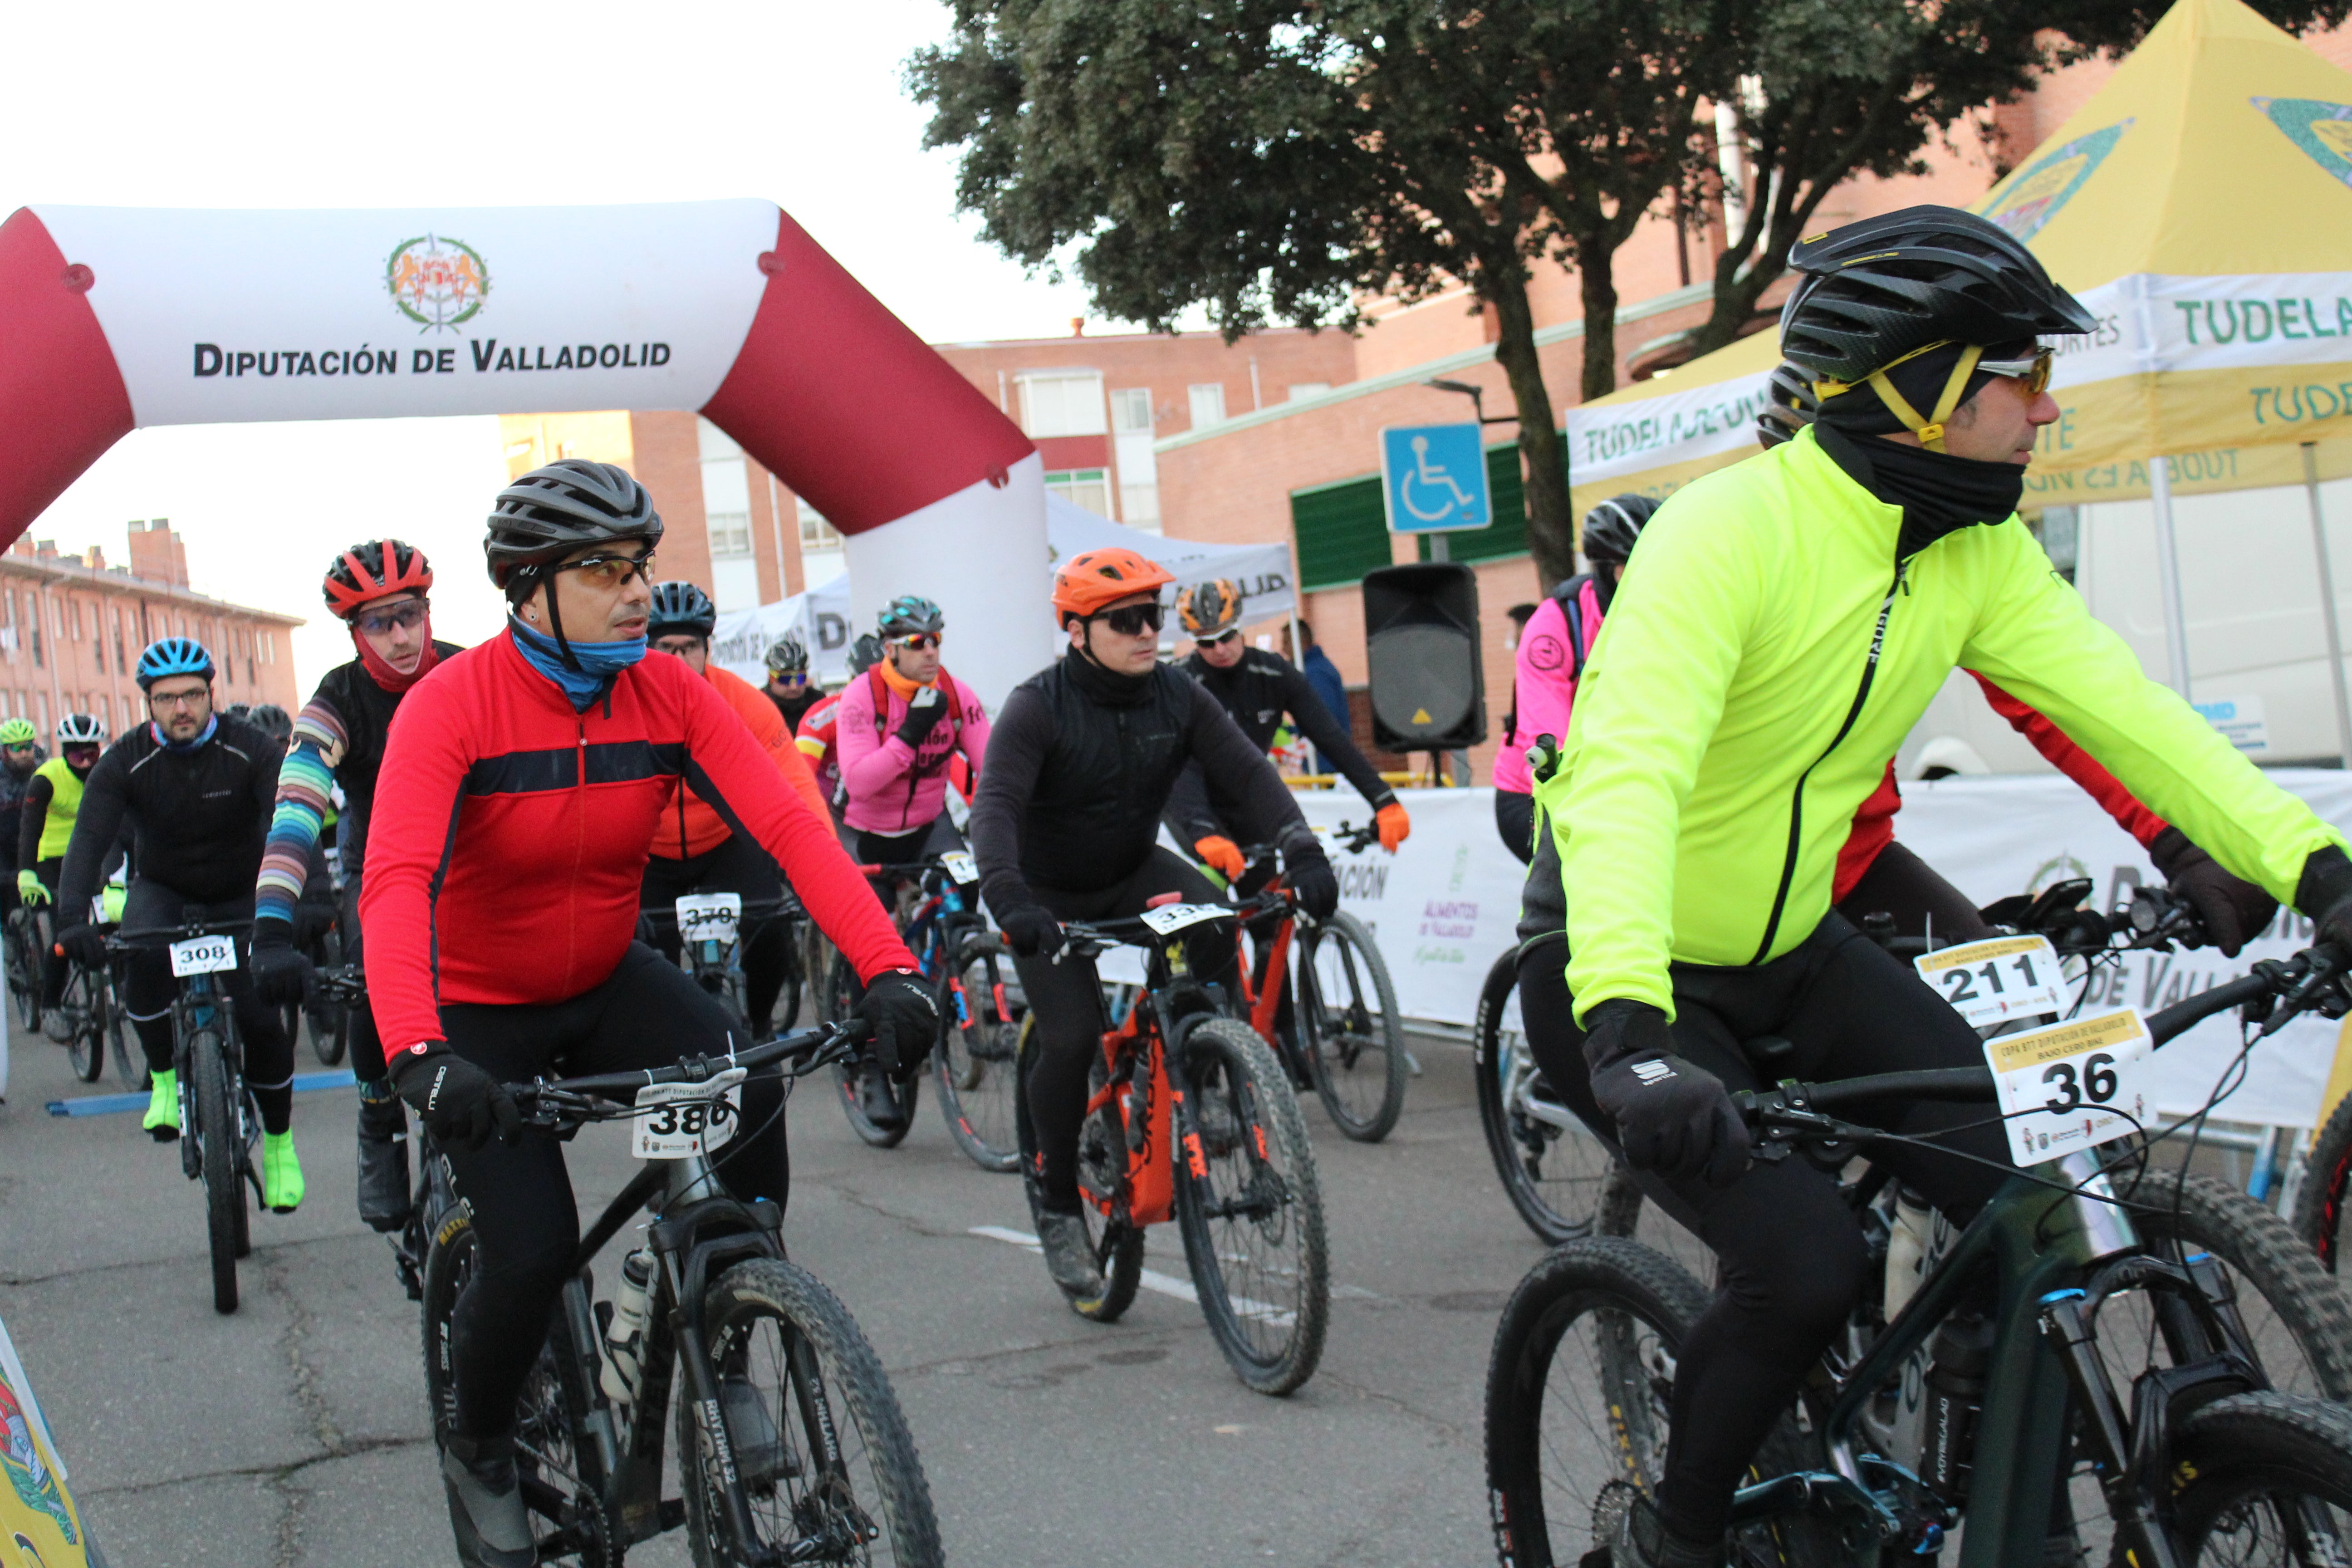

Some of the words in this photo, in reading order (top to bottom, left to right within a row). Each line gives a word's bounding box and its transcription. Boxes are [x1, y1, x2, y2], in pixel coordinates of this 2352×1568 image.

[193, 343, 397, 377] DIPUTACIÓN
[412, 348, 455, 373] DE
[471, 339, 671, 372] VALLADOLID
[180, 946, 225, 962] 308
[1944, 954, 2038, 1004] 211
[2087, 968, 2128, 1006] DE
[2043, 1053, 2117, 1115] 36
[706, 1399, 731, 1464] RHYTHM
